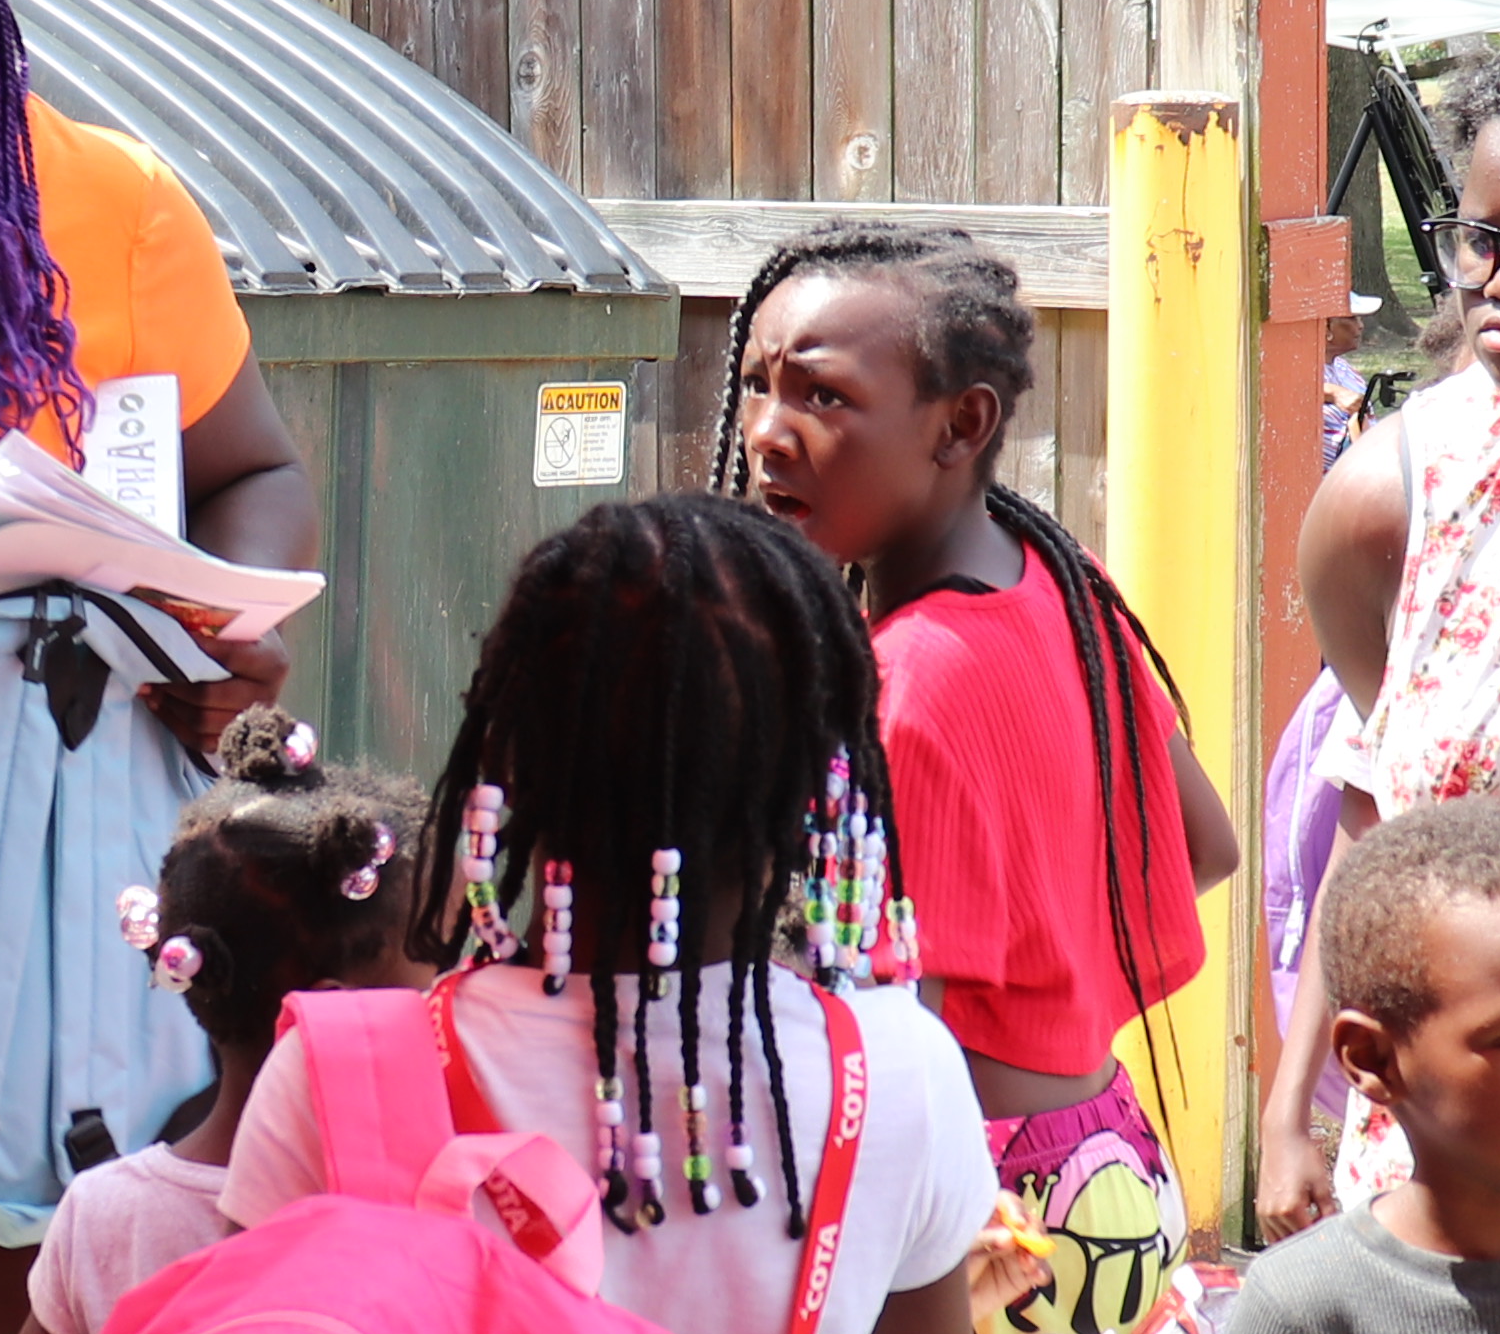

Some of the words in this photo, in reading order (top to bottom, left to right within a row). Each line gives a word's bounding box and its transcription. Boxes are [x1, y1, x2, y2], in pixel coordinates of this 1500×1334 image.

[556, 392, 619, 410] CAUTION
[840, 1050, 866, 1141] COTA
[806, 1223, 839, 1313] COTA
